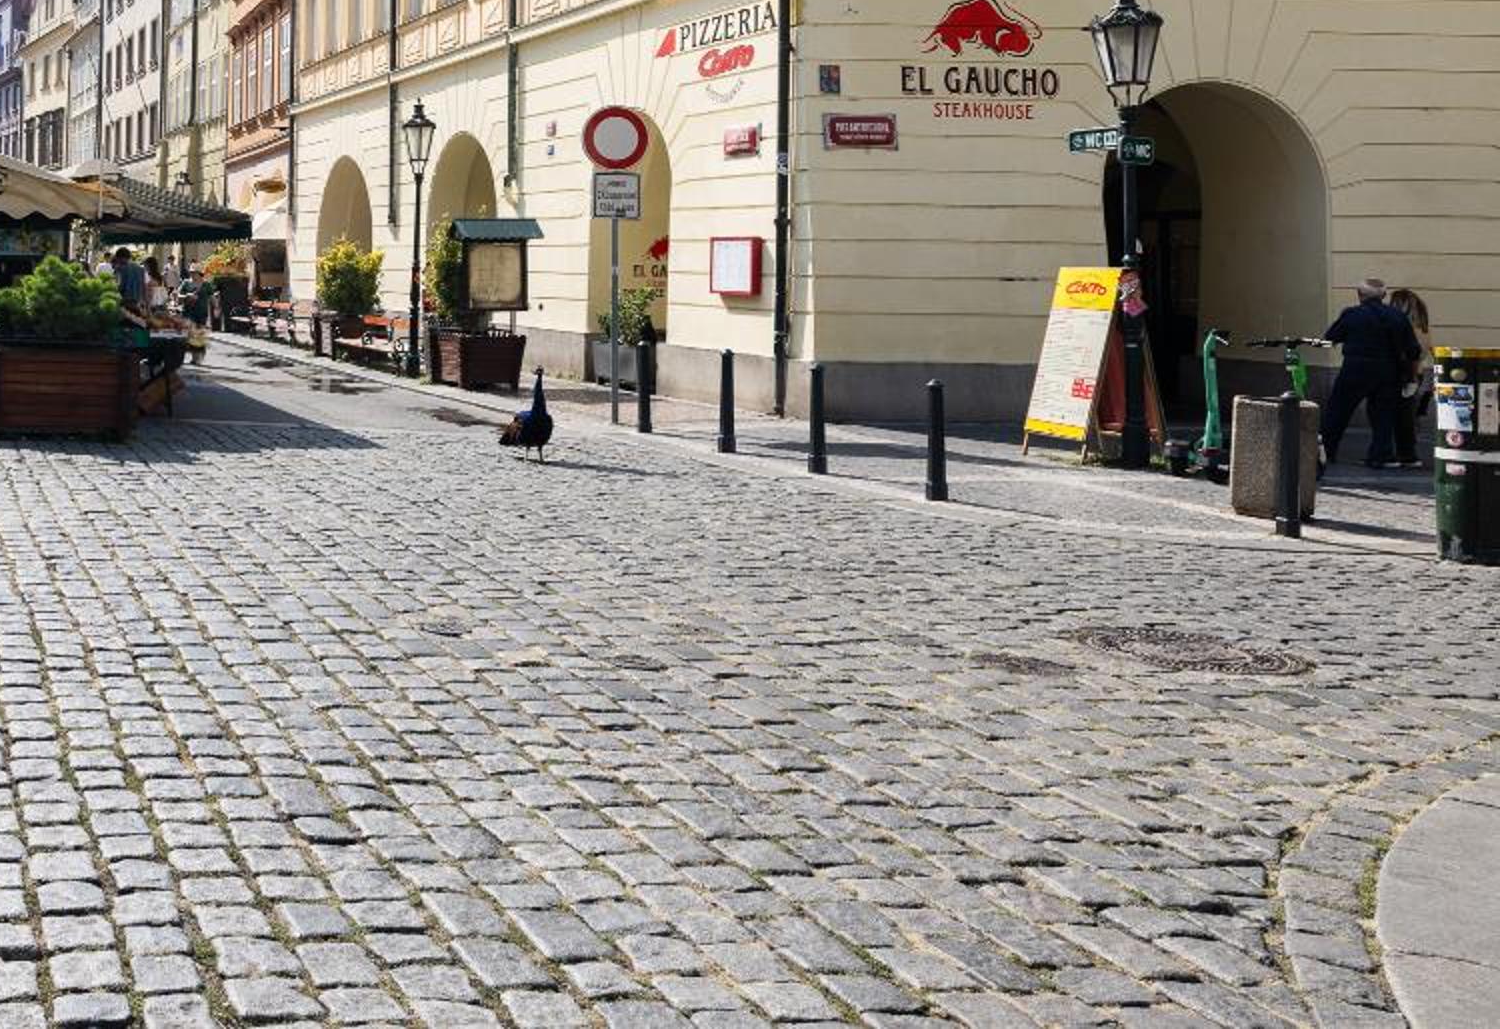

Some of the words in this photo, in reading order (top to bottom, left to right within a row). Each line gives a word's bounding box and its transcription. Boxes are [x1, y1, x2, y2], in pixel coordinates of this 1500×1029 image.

[680, 0, 778, 52] PIZZERIA
[901, 65, 933, 94] EL
[944, 66, 1060, 97] GAUCHO
[932, 102, 1035, 120] STEAKHOUSE
